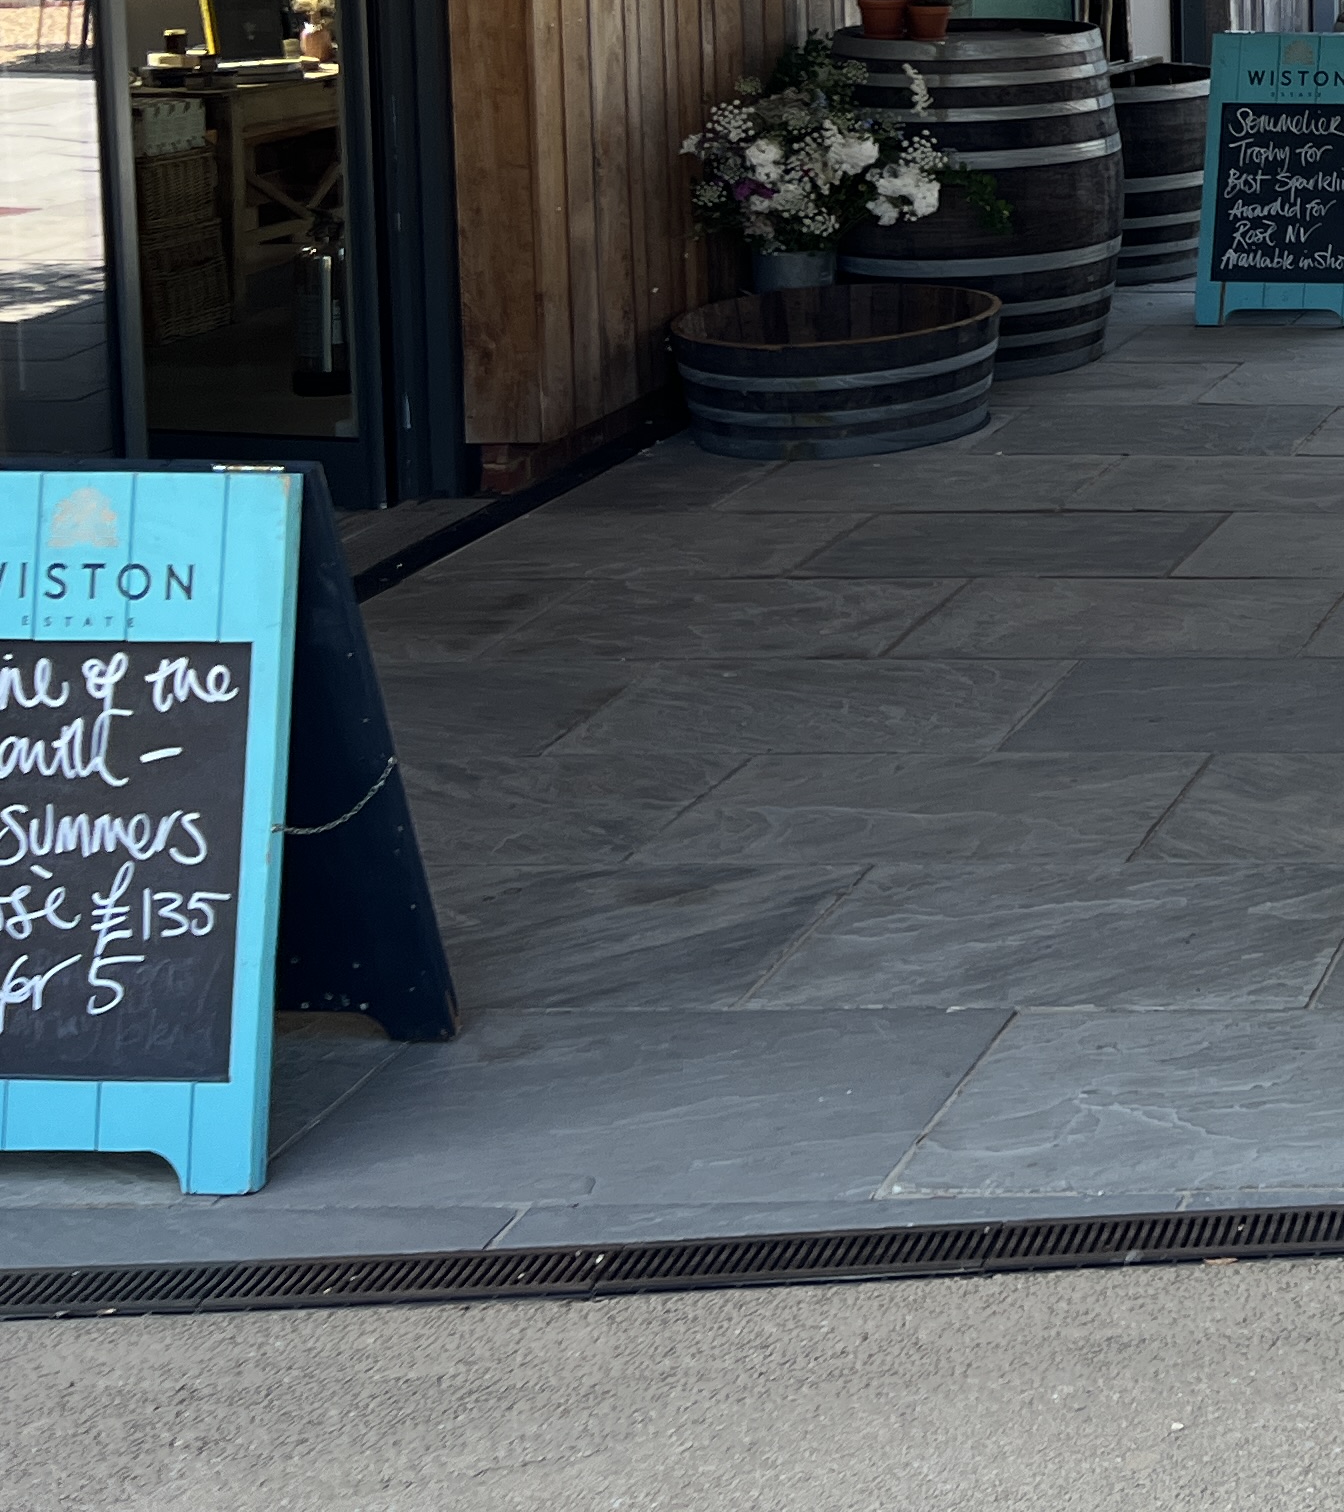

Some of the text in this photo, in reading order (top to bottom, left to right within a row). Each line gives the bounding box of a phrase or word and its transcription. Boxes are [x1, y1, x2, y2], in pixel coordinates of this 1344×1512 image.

[1228, 138, 1290, 174] Trophy
[1223, 168, 1272, 199] Best
[1227, 196, 1301, 221] Awarded
[1220, 245, 1295, 270] Available
[1299, 249, 1314, 271] in
[0, 561, 196, 601] ISTON
[21, 615, 136, 628] ESTATE
[144, 656, 240, 714] the
[86, 954, 146, 1016] 5
